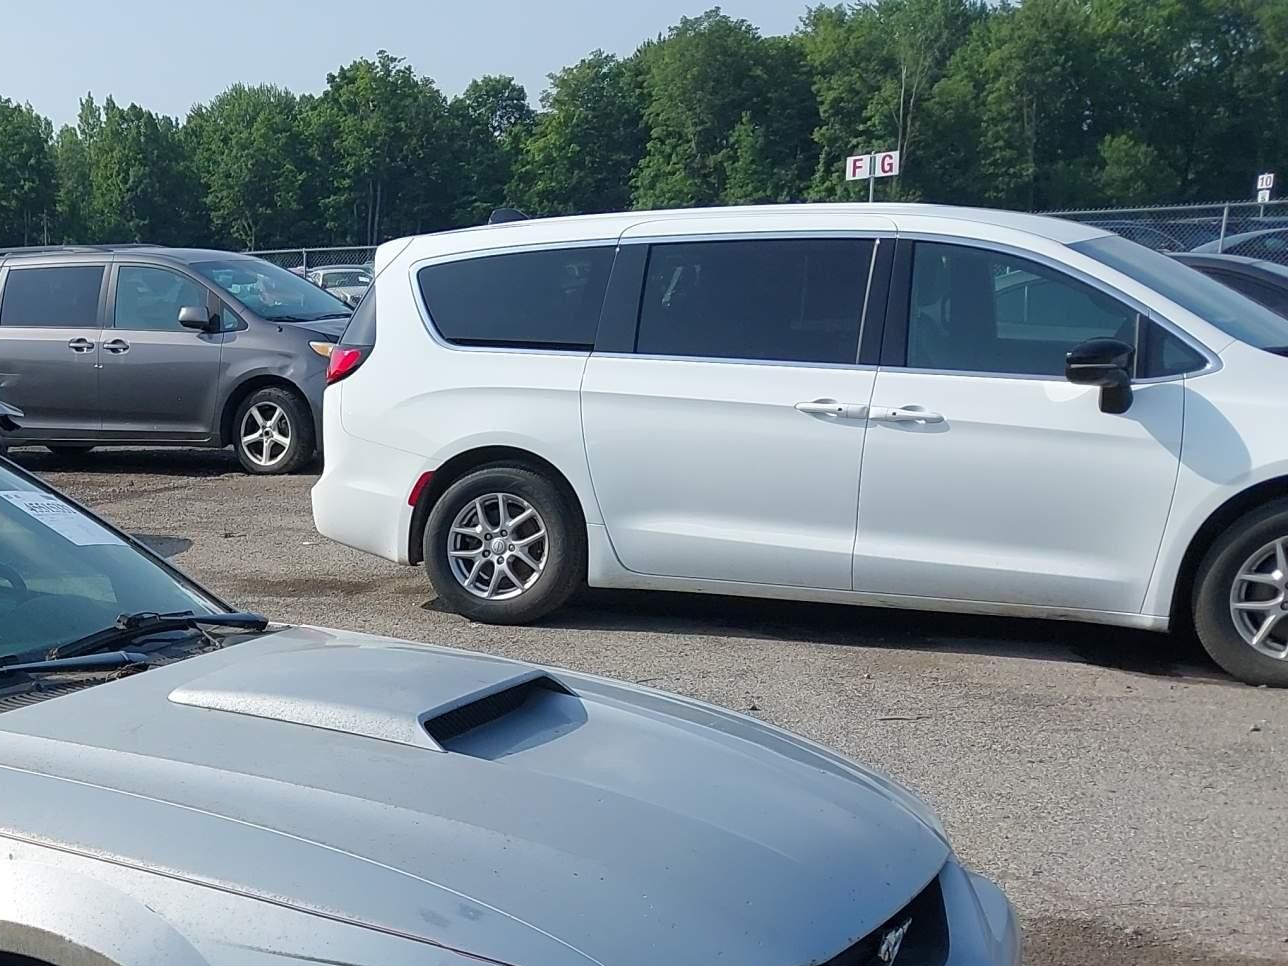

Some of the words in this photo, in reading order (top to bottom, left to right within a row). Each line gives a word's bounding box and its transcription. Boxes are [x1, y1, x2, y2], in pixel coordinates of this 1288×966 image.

[852, 158, 863, 177] F
[880, 154, 894, 174] G
[1259, 175, 1273, 187] 10
